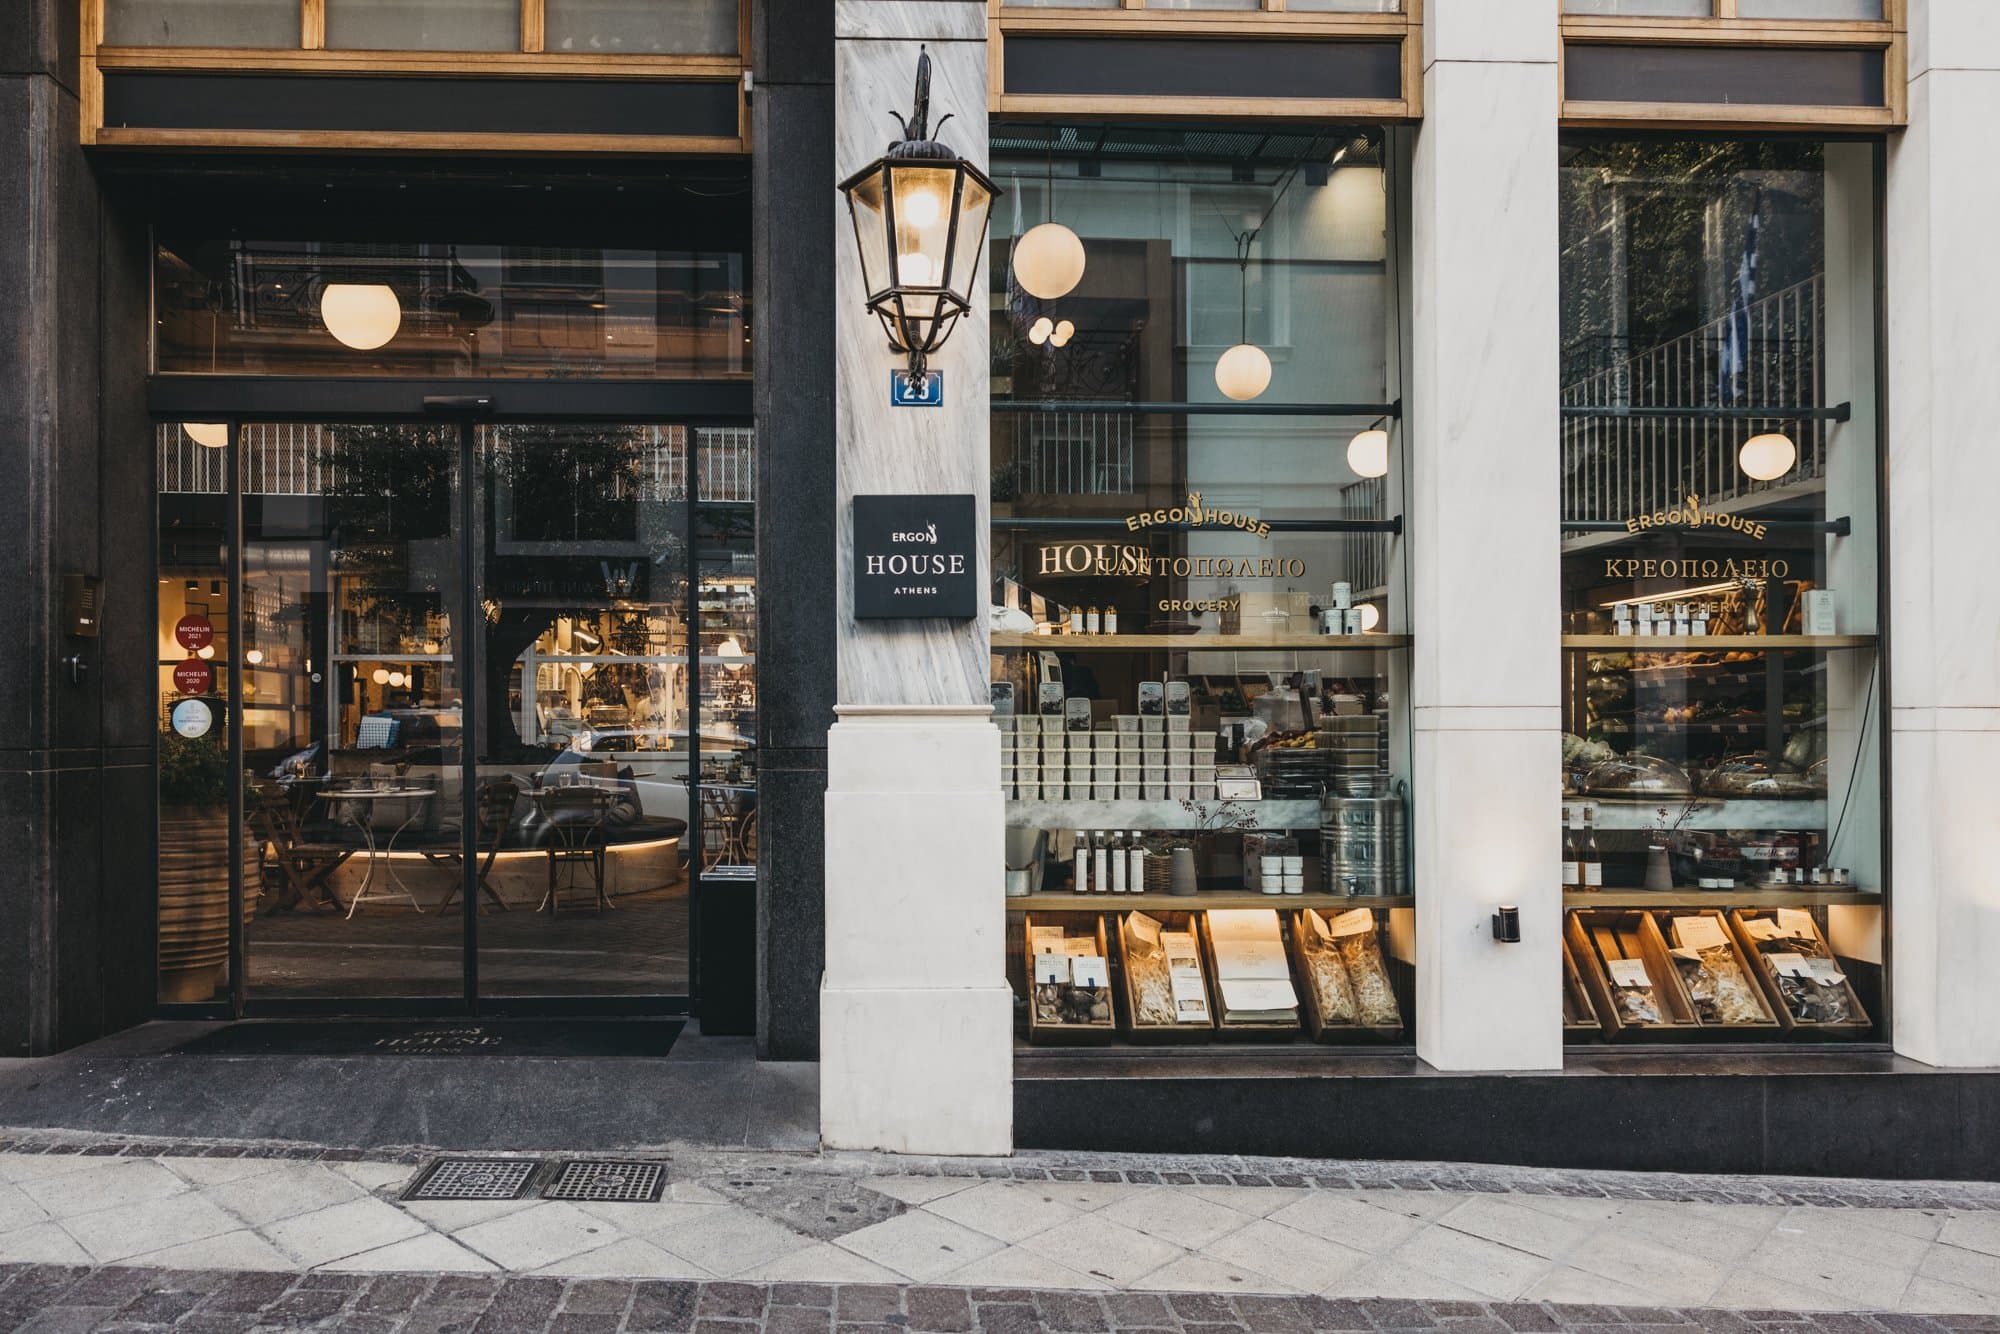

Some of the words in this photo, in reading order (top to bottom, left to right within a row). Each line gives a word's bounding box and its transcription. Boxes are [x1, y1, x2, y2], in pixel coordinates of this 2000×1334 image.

[903, 376, 930, 400] 23
[1125, 506, 1203, 531] ERGON
[1206, 508, 1271, 538] HOUSE
[1626, 509, 1700, 534] ERGON
[1704, 511, 1767, 540] HOUSE
[892, 531, 937, 543] ERGON
[866, 554, 965, 575] HOUSE
[1039, 543, 1151, 575] HOUSE
[1093, 556, 1306, 578] ΠΑΝΤΟΠΩΛΕΙΟ
[1605, 558, 1789, 579] ΚΡΕΟΠΩΛΕΙΟ
[894, 586, 937, 595] ATHENS
[1158, 599, 1241, 612] GROCERY
[1654, 601, 1741, 614] BUTCHERY
